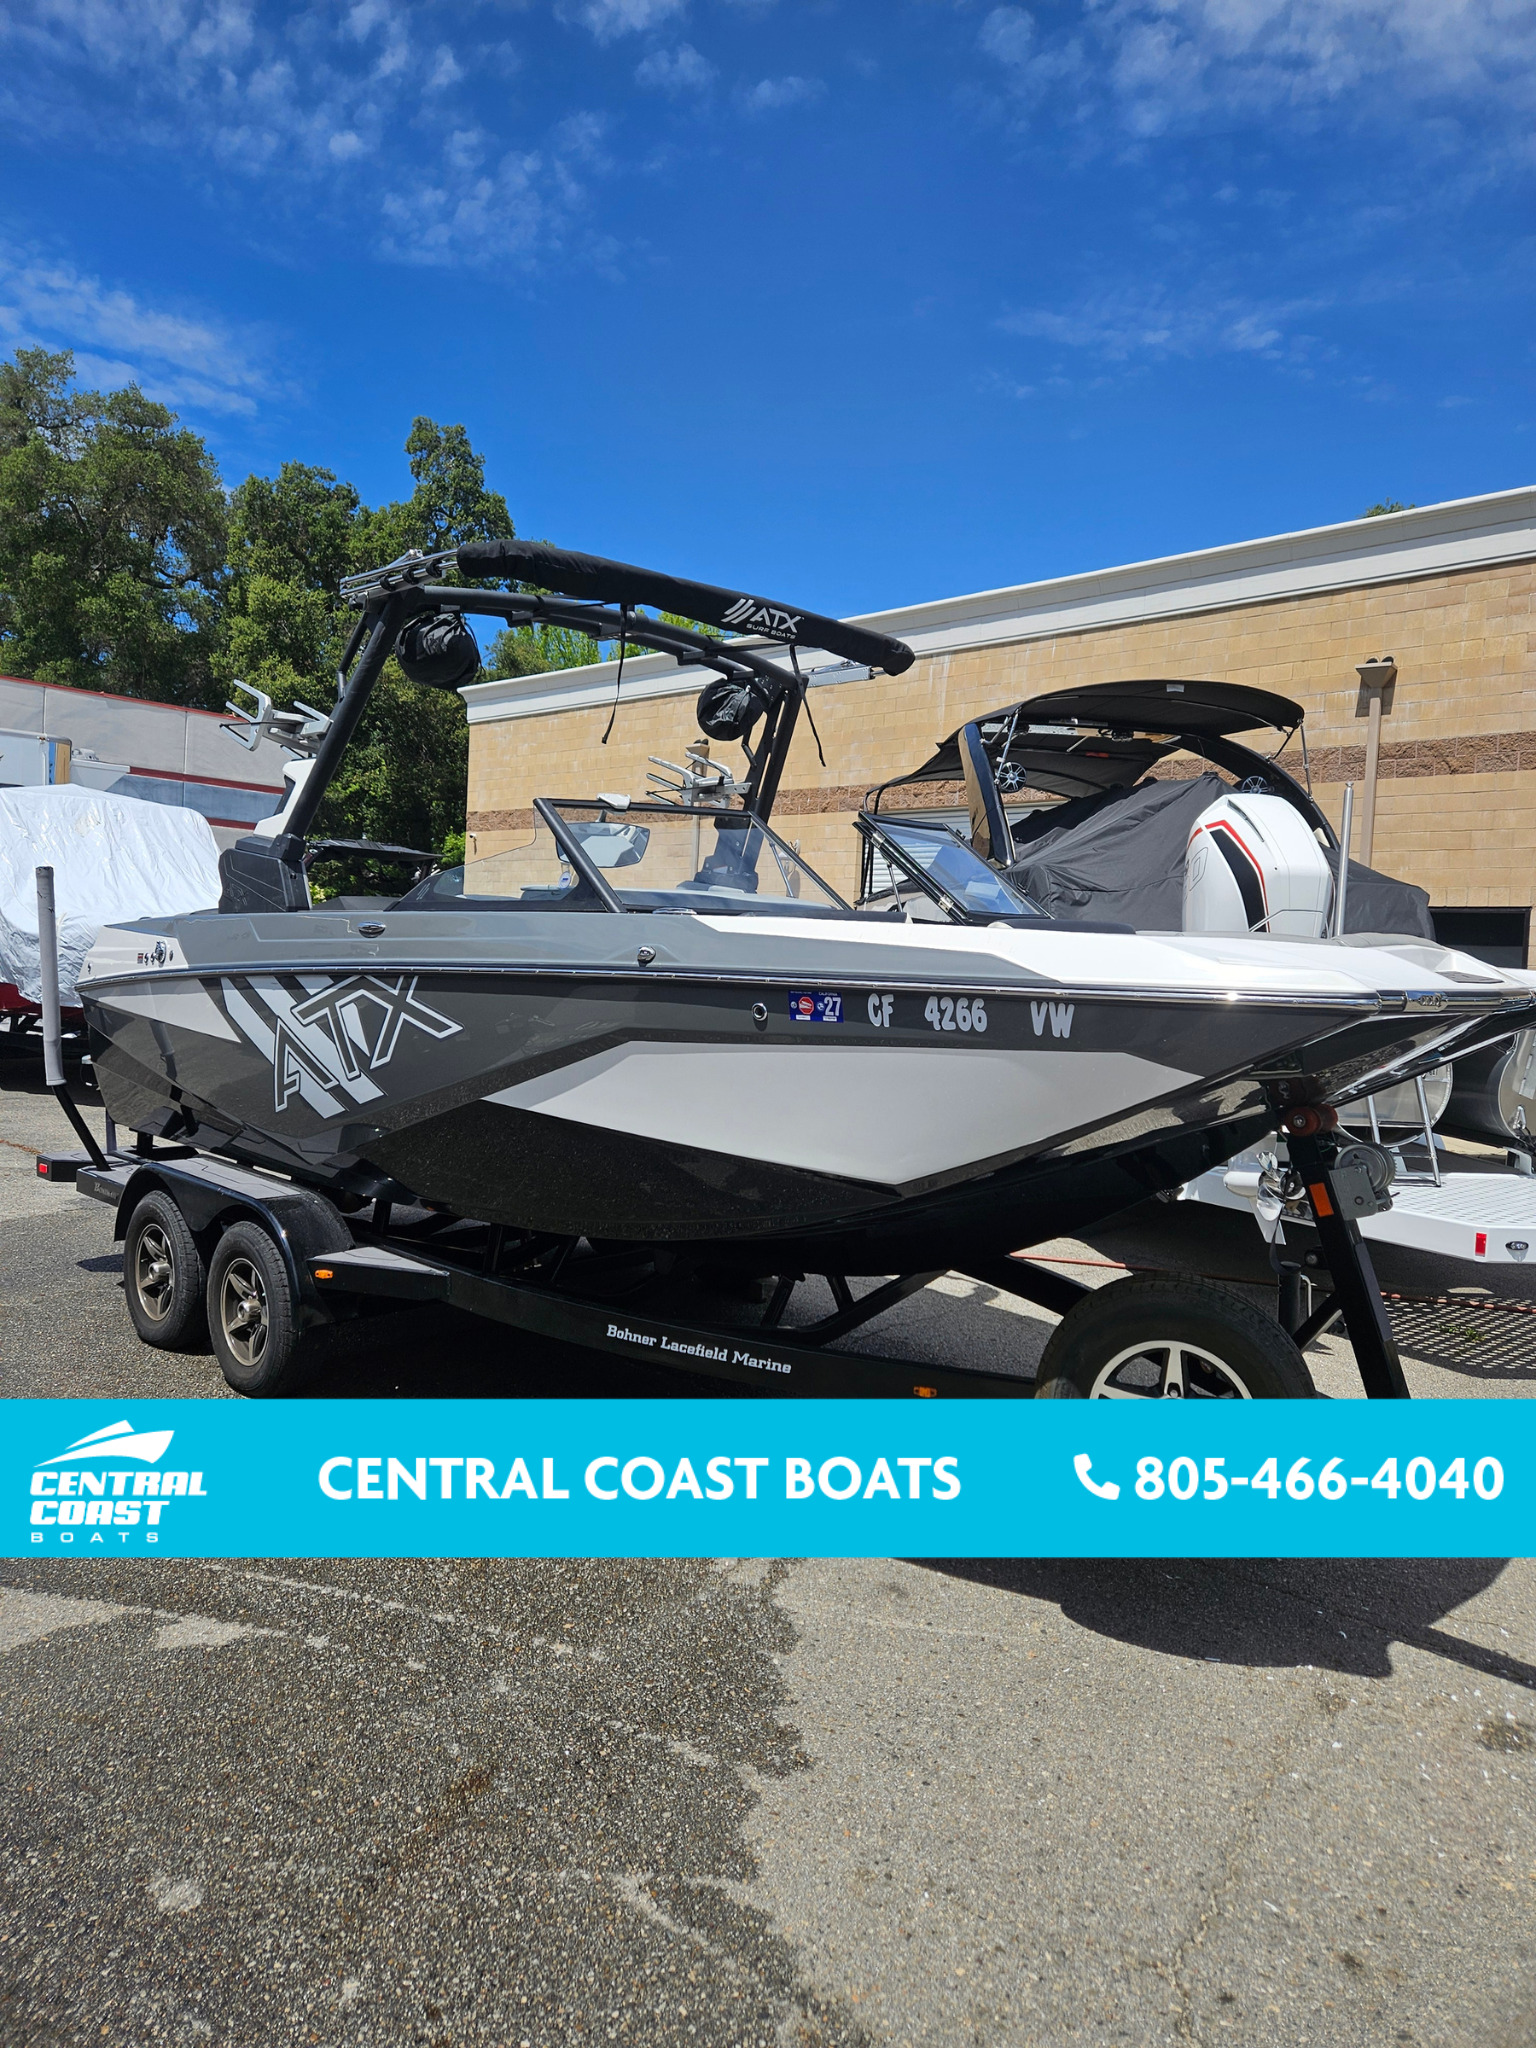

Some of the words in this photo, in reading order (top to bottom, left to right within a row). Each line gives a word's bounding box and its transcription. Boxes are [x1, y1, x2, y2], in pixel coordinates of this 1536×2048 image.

[746, 623, 770, 633] SURF
[770, 629, 797, 640] BOATS
[749, 606, 802, 634] ATX
[823, 996, 842, 1017] 27
[867, 993, 895, 1028] CF
[924, 995, 988, 1033] 4266
[1030, 1001, 1075, 1039] VW
[274, 974, 464, 1112] ATX
[606, 1324, 657, 1347] Bohner
[660, 1336, 728, 1362] Lacefield
[731, 1350, 792, 1374] Marine
